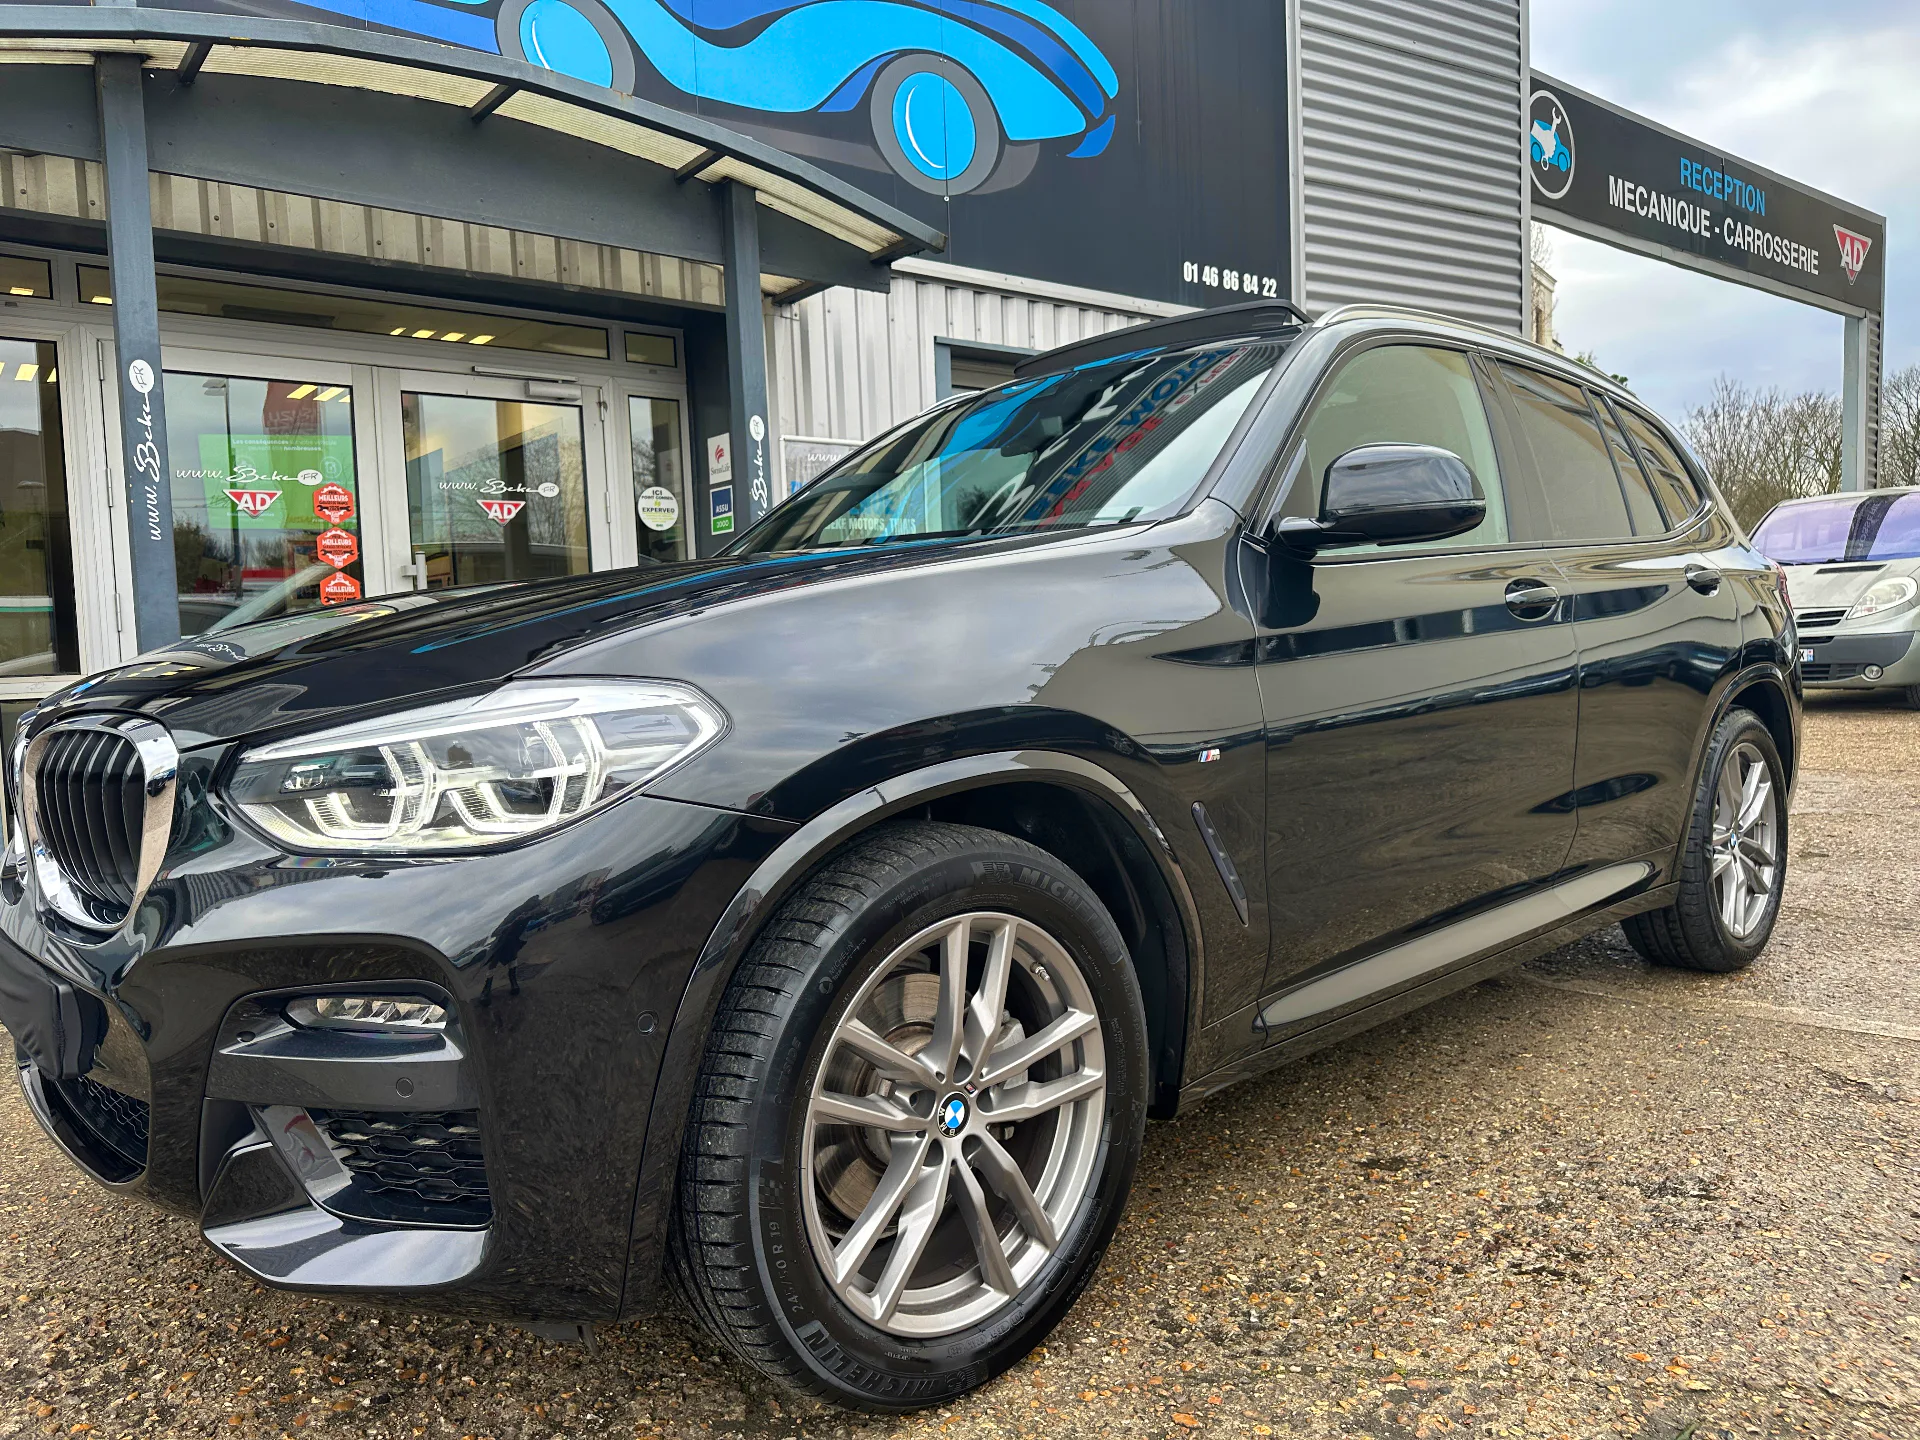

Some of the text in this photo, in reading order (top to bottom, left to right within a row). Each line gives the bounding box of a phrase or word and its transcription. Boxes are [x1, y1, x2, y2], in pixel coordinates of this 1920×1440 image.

[1680, 157, 1766, 217] RECEPTION
[1608, 175, 1711, 239] MECANIQUE
[1723, 217, 1819, 276] CARROSSERIE
[1840, 236, 1864, 272] AD
[1183, 261, 1277, 298] 01 46 86 84 22
[237, 493, 272, 511] AD
[318, 494, 349, 502] MEILLEURS
[488, 503, 517, 520] AD
[716, 503, 729, 513] ASSU
